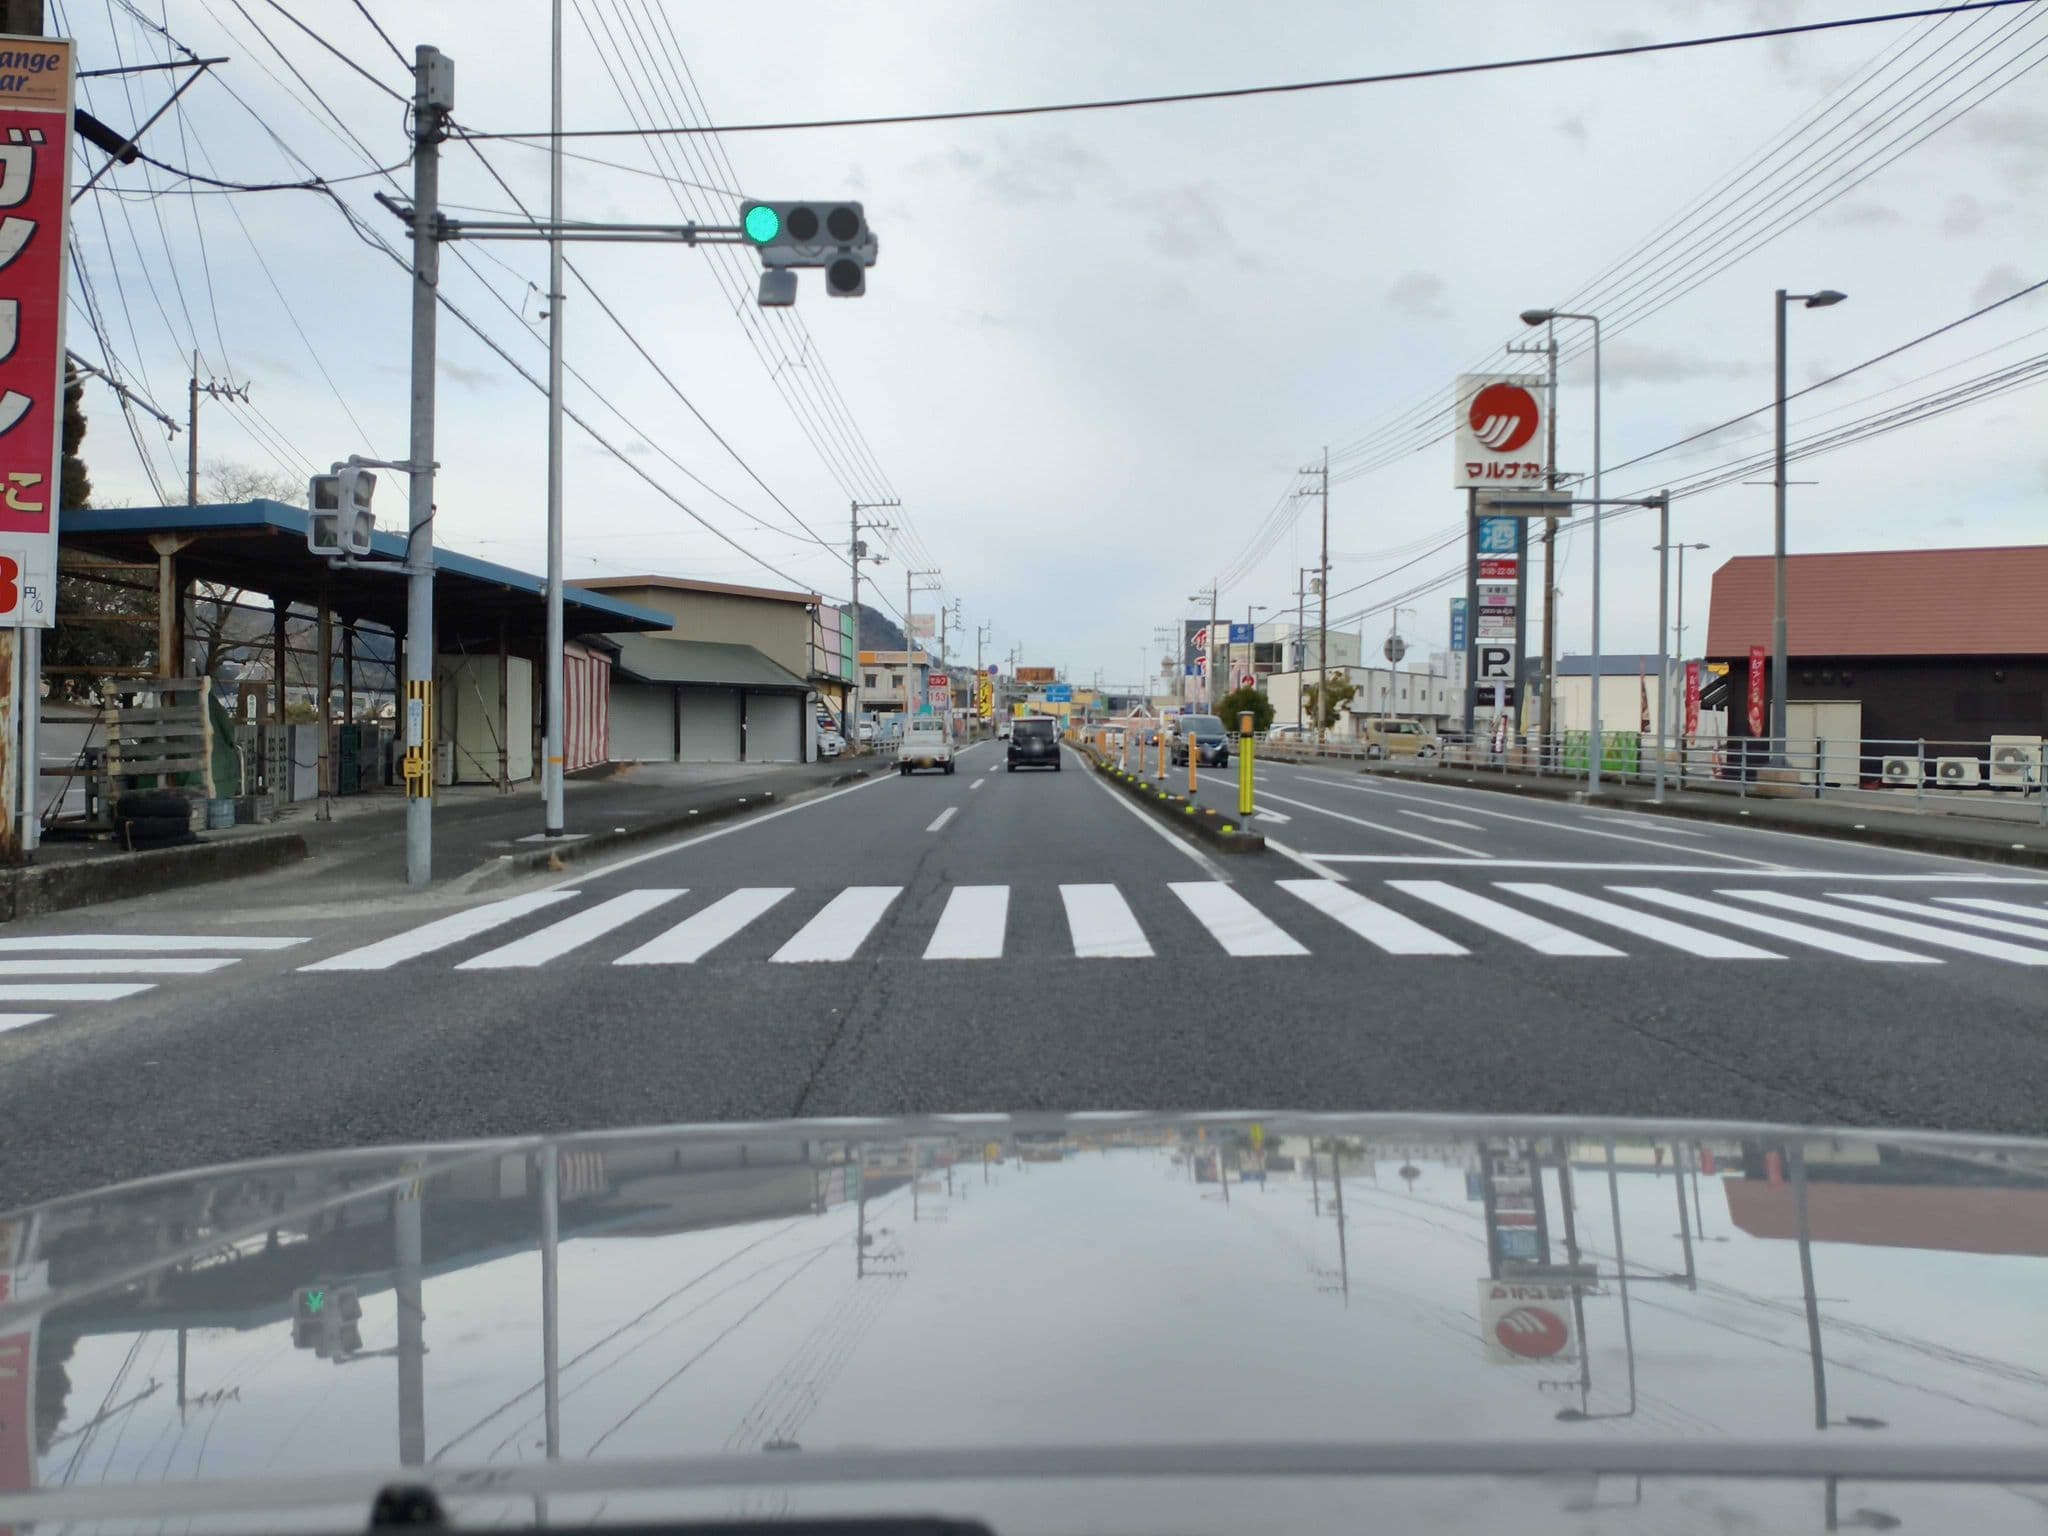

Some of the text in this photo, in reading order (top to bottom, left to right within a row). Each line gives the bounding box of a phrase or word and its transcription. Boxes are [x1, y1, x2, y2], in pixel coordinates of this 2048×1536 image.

[1465, 461, 1541, 480] マルナカ
[0, 472, 43, 511] こ
[1481, 519, 1517, 550] 酒
[1482, 647, 1511, 678] P
[930, 677, 946, 685] セルフ
